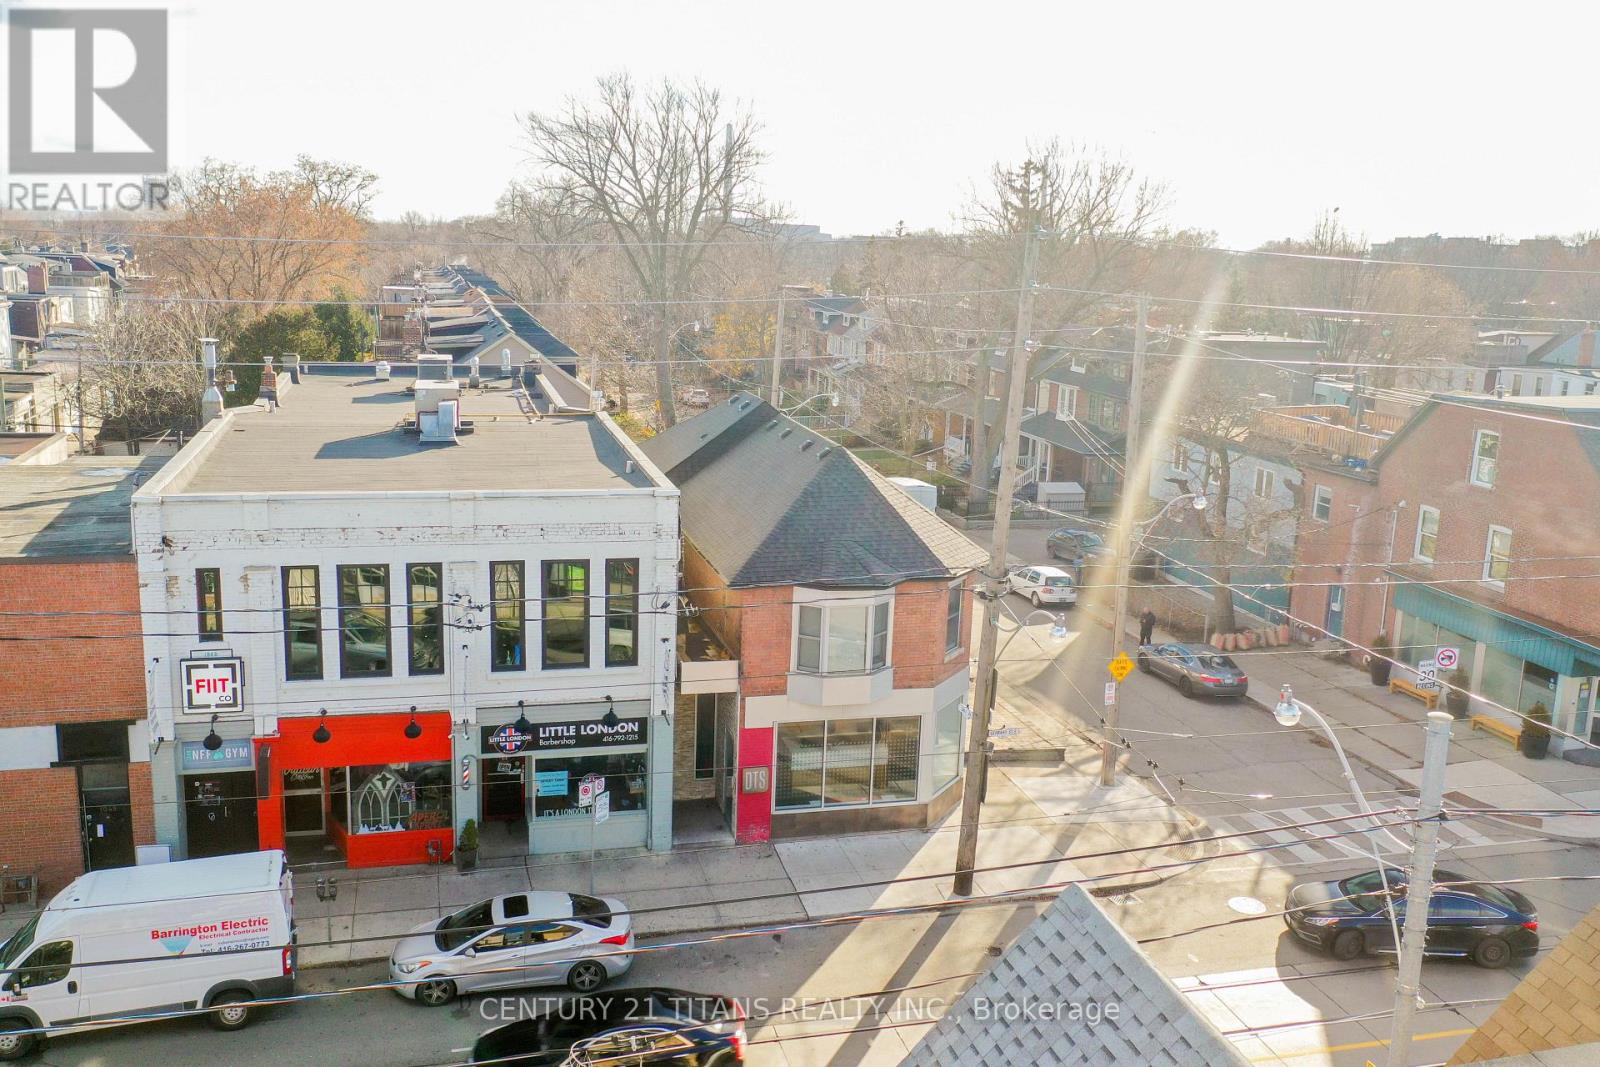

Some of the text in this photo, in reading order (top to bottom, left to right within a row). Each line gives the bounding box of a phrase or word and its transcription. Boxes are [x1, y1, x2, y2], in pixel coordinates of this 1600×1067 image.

[1419, 669, 1435, 681] 30
[195, 678, 229, 693] FIIT
[540, 725, 576, 737] LITTLE
[540, 737, 576, 746] Barbershop
[225, 747, 248, 759] GYM
[560, 807, 586, 816] LONDON
[151, 917, 269, 939] Barrington Electric
[199, 931, 231, 940] Electrical
[233, 926, 269, 936] Contractor
